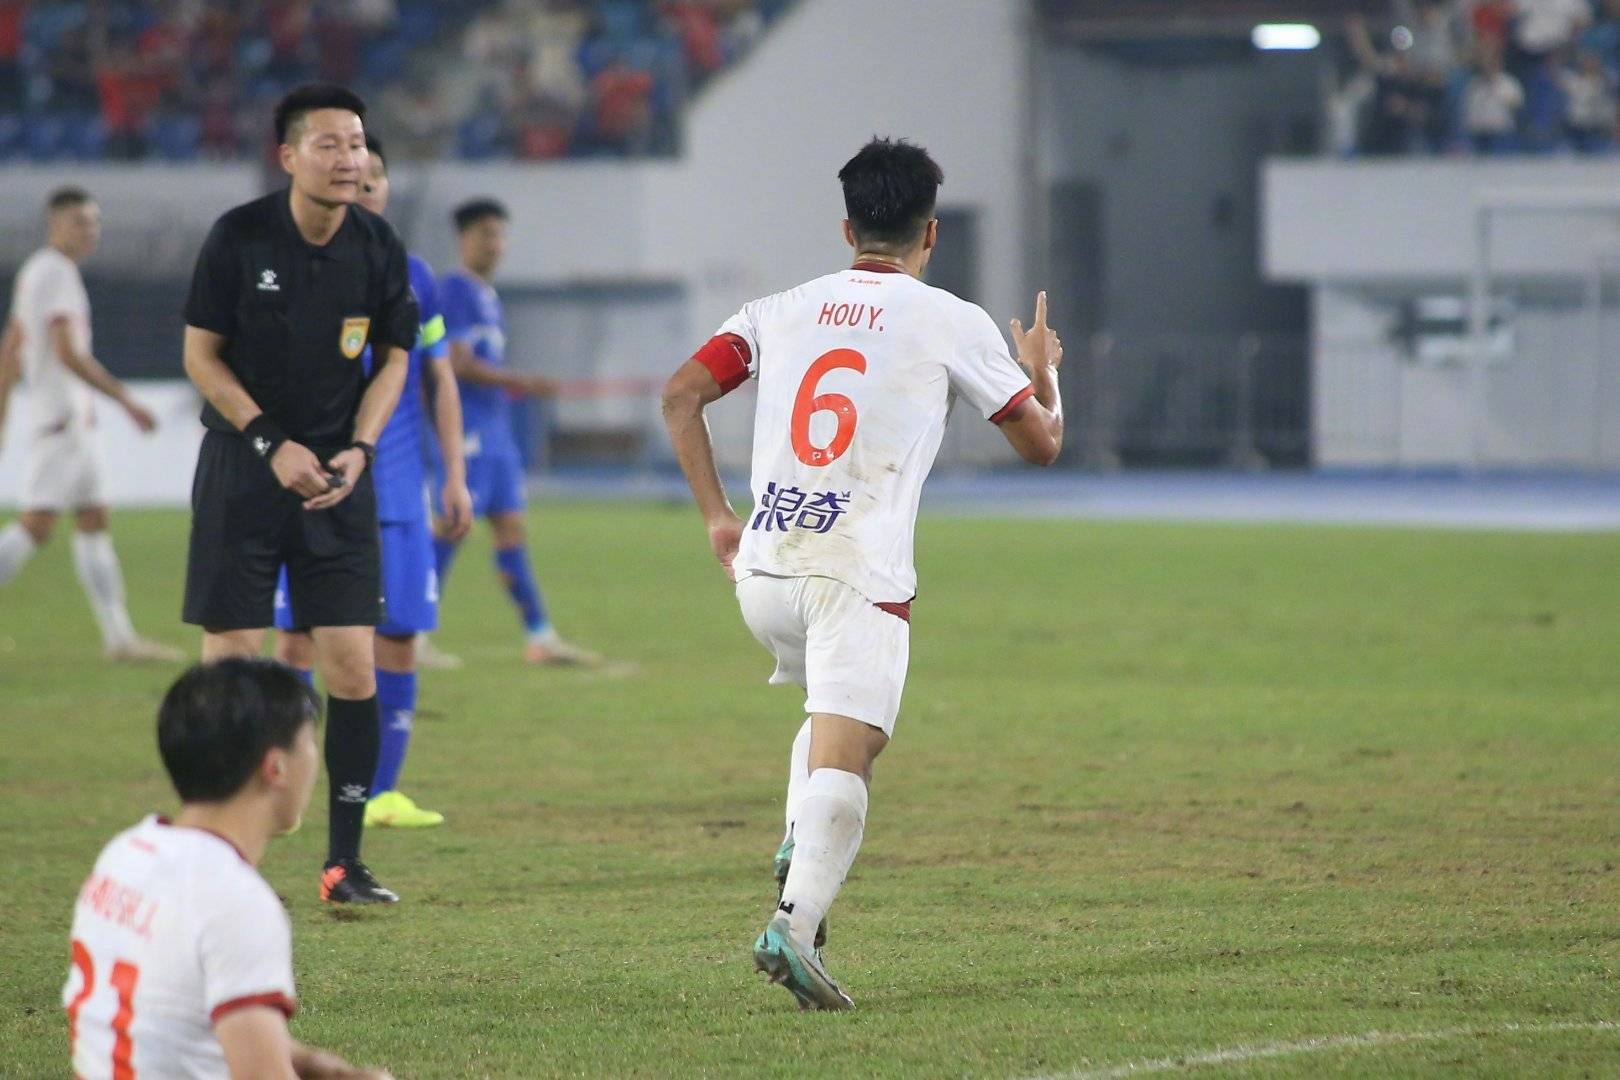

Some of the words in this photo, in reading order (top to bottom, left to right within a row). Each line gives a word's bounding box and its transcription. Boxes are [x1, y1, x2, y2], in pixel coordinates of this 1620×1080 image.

[818, 302, 864, 327] HOU
[868, 306, 884, 331] Y.
[790, 348, 867, 467] 6
[752, 482, 851, 533] 浪奇
